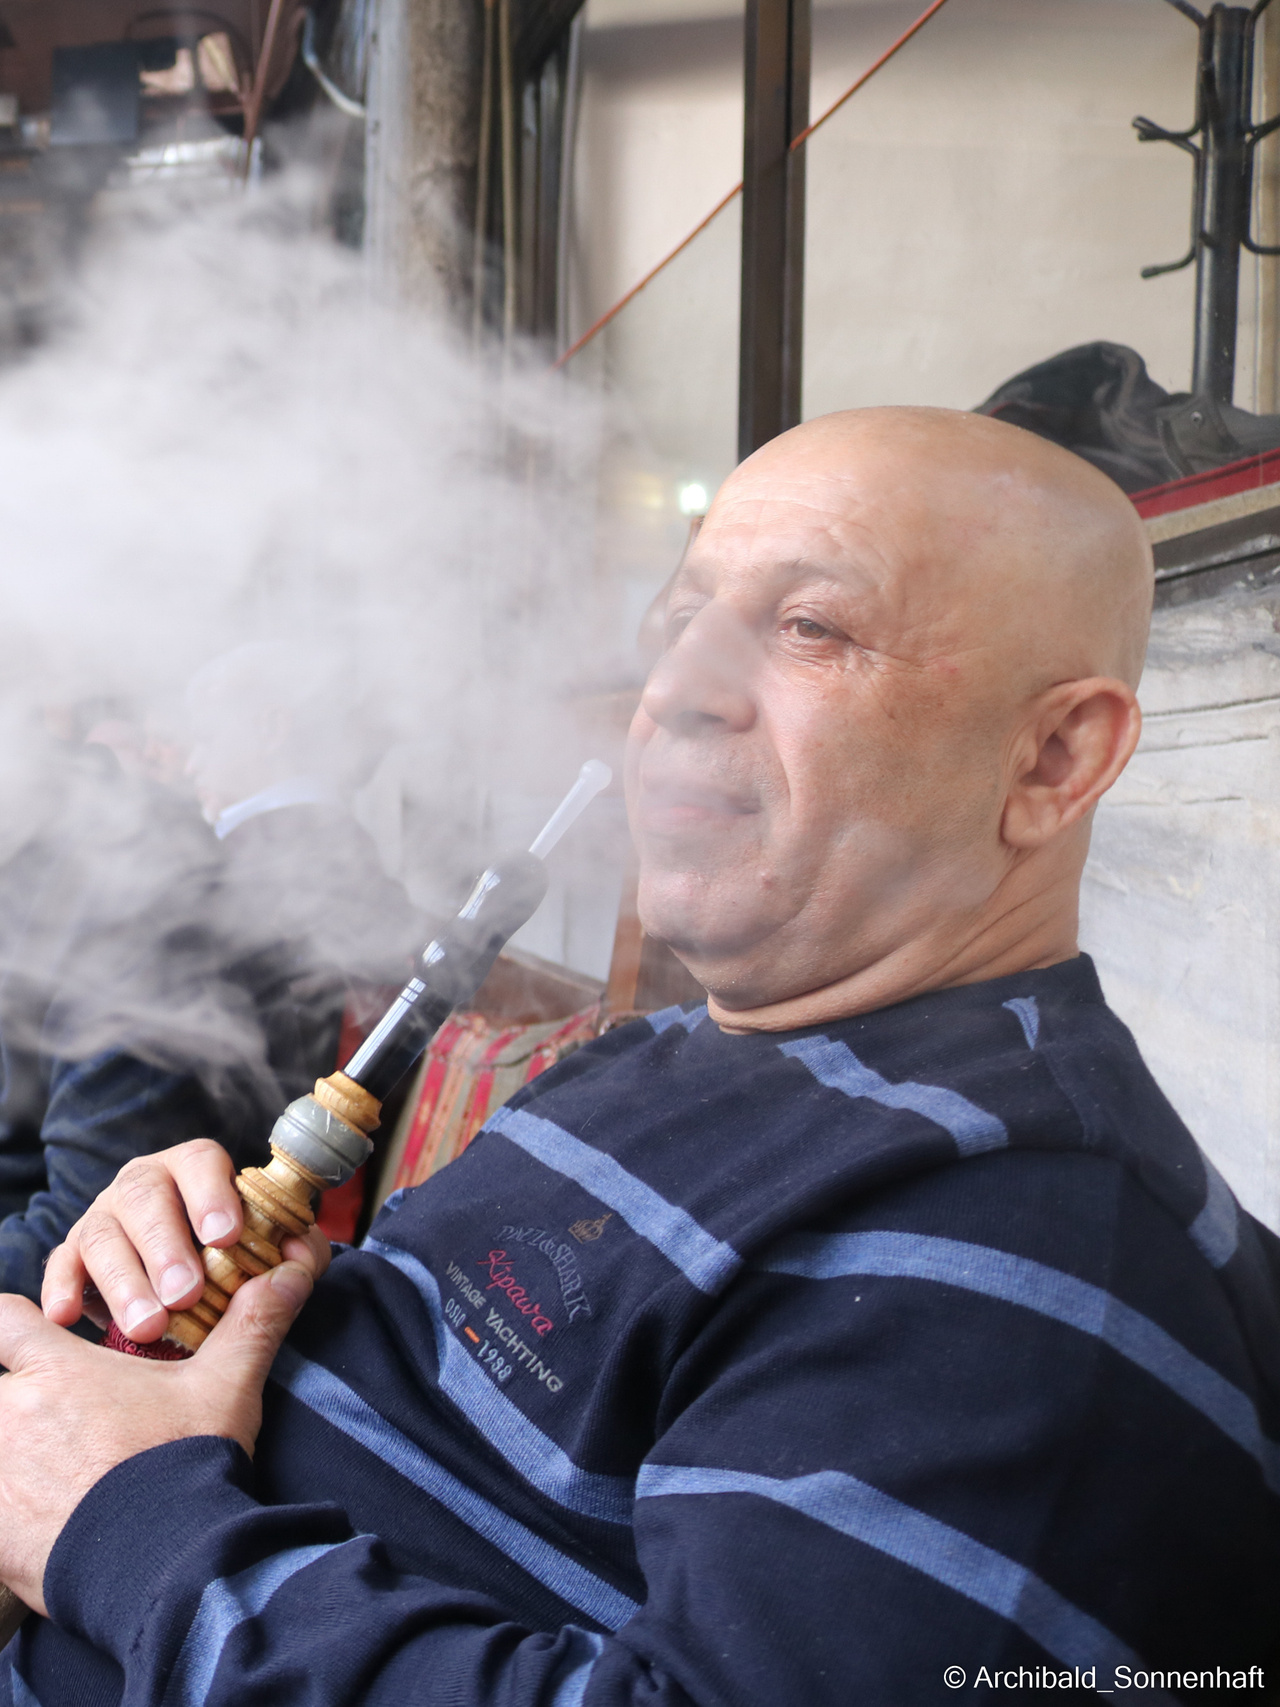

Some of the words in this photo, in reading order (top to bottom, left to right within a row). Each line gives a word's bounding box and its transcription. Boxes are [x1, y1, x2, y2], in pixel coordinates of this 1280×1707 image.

[444, 1298, 466, 1327] OSLO
[445, 1260, 487, 1309] VINTAGE
[485, 1307, 564, 1393] YACHTING
[477, 1249, 554, 1337] Kipawa
